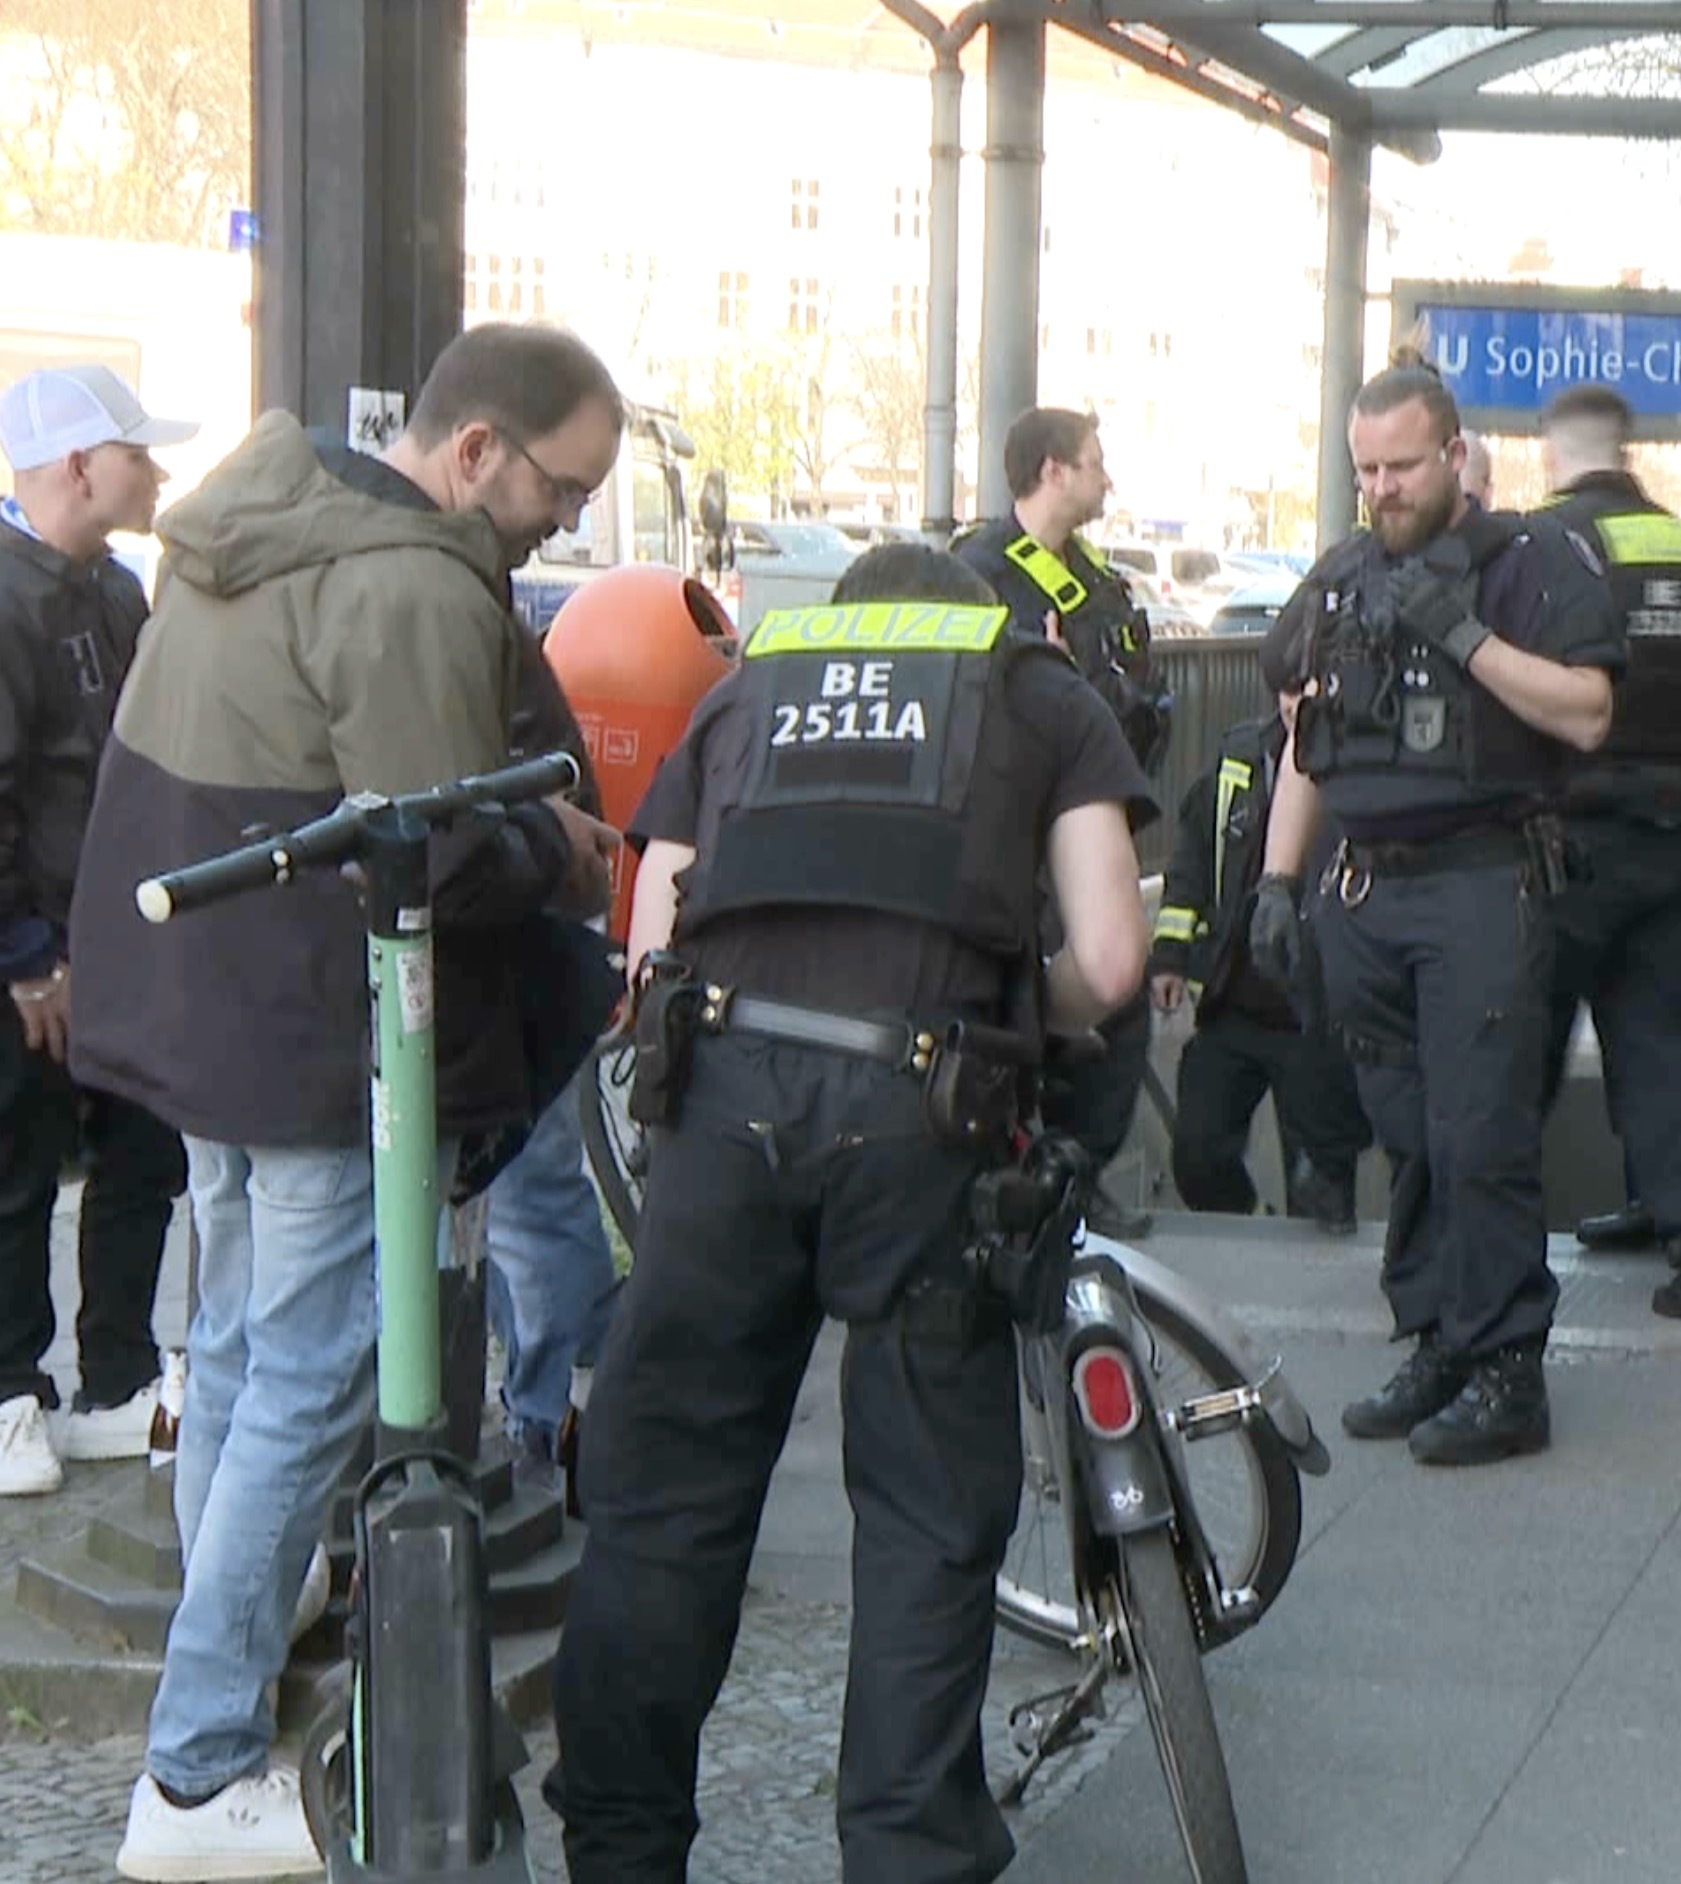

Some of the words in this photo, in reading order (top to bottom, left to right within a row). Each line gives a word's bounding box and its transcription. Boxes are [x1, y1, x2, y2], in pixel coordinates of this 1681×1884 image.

[1437, 336, 1469, 375] U
[758, 606, 996, 648] POLIZEI
[820, 662, 894, 697] BE
[770, 700, 926, 747] 2511A
